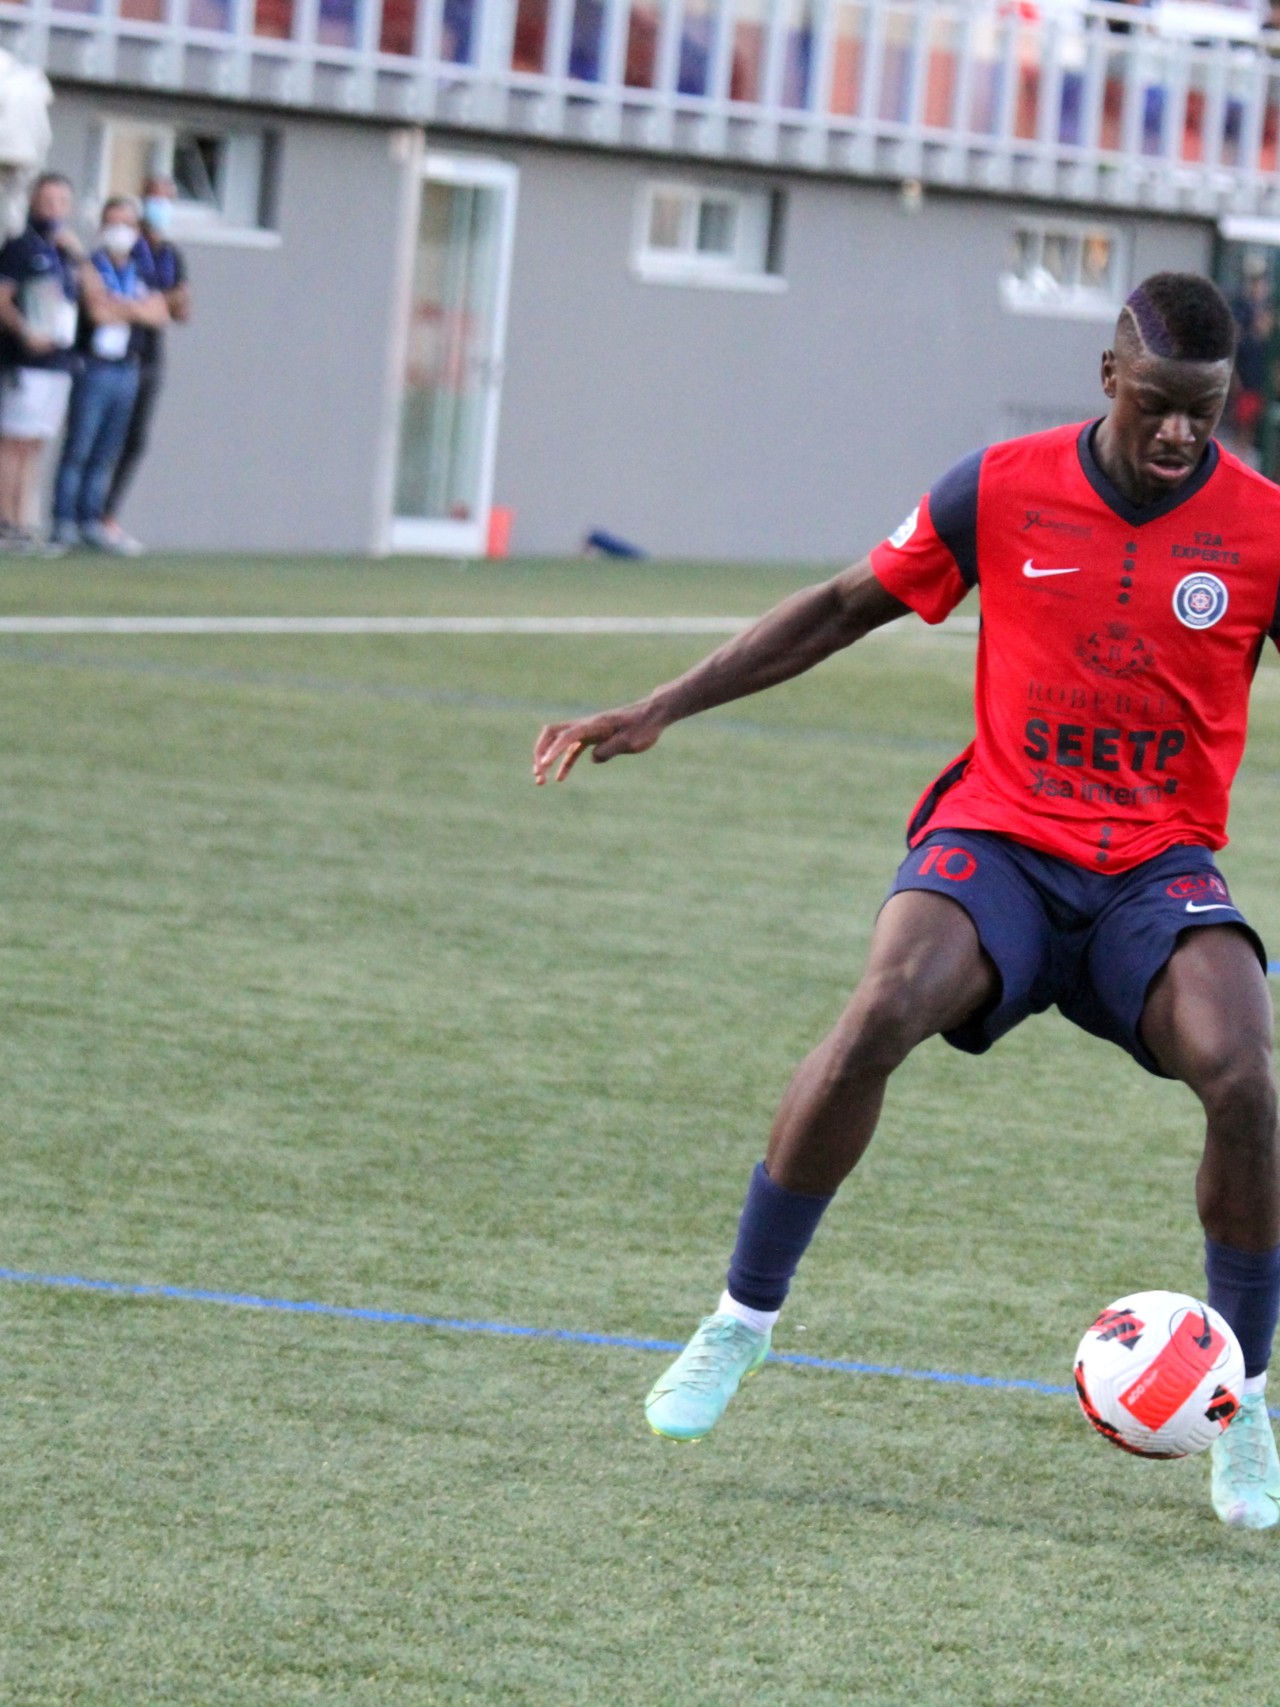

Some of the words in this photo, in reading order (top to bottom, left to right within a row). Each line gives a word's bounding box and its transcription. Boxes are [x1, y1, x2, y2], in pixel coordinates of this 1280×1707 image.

[1171, 543, 1240, 566] EXPERTS
[1024, 717, 1186, 772] SEETP
[917, 845, 977, 882] 10
